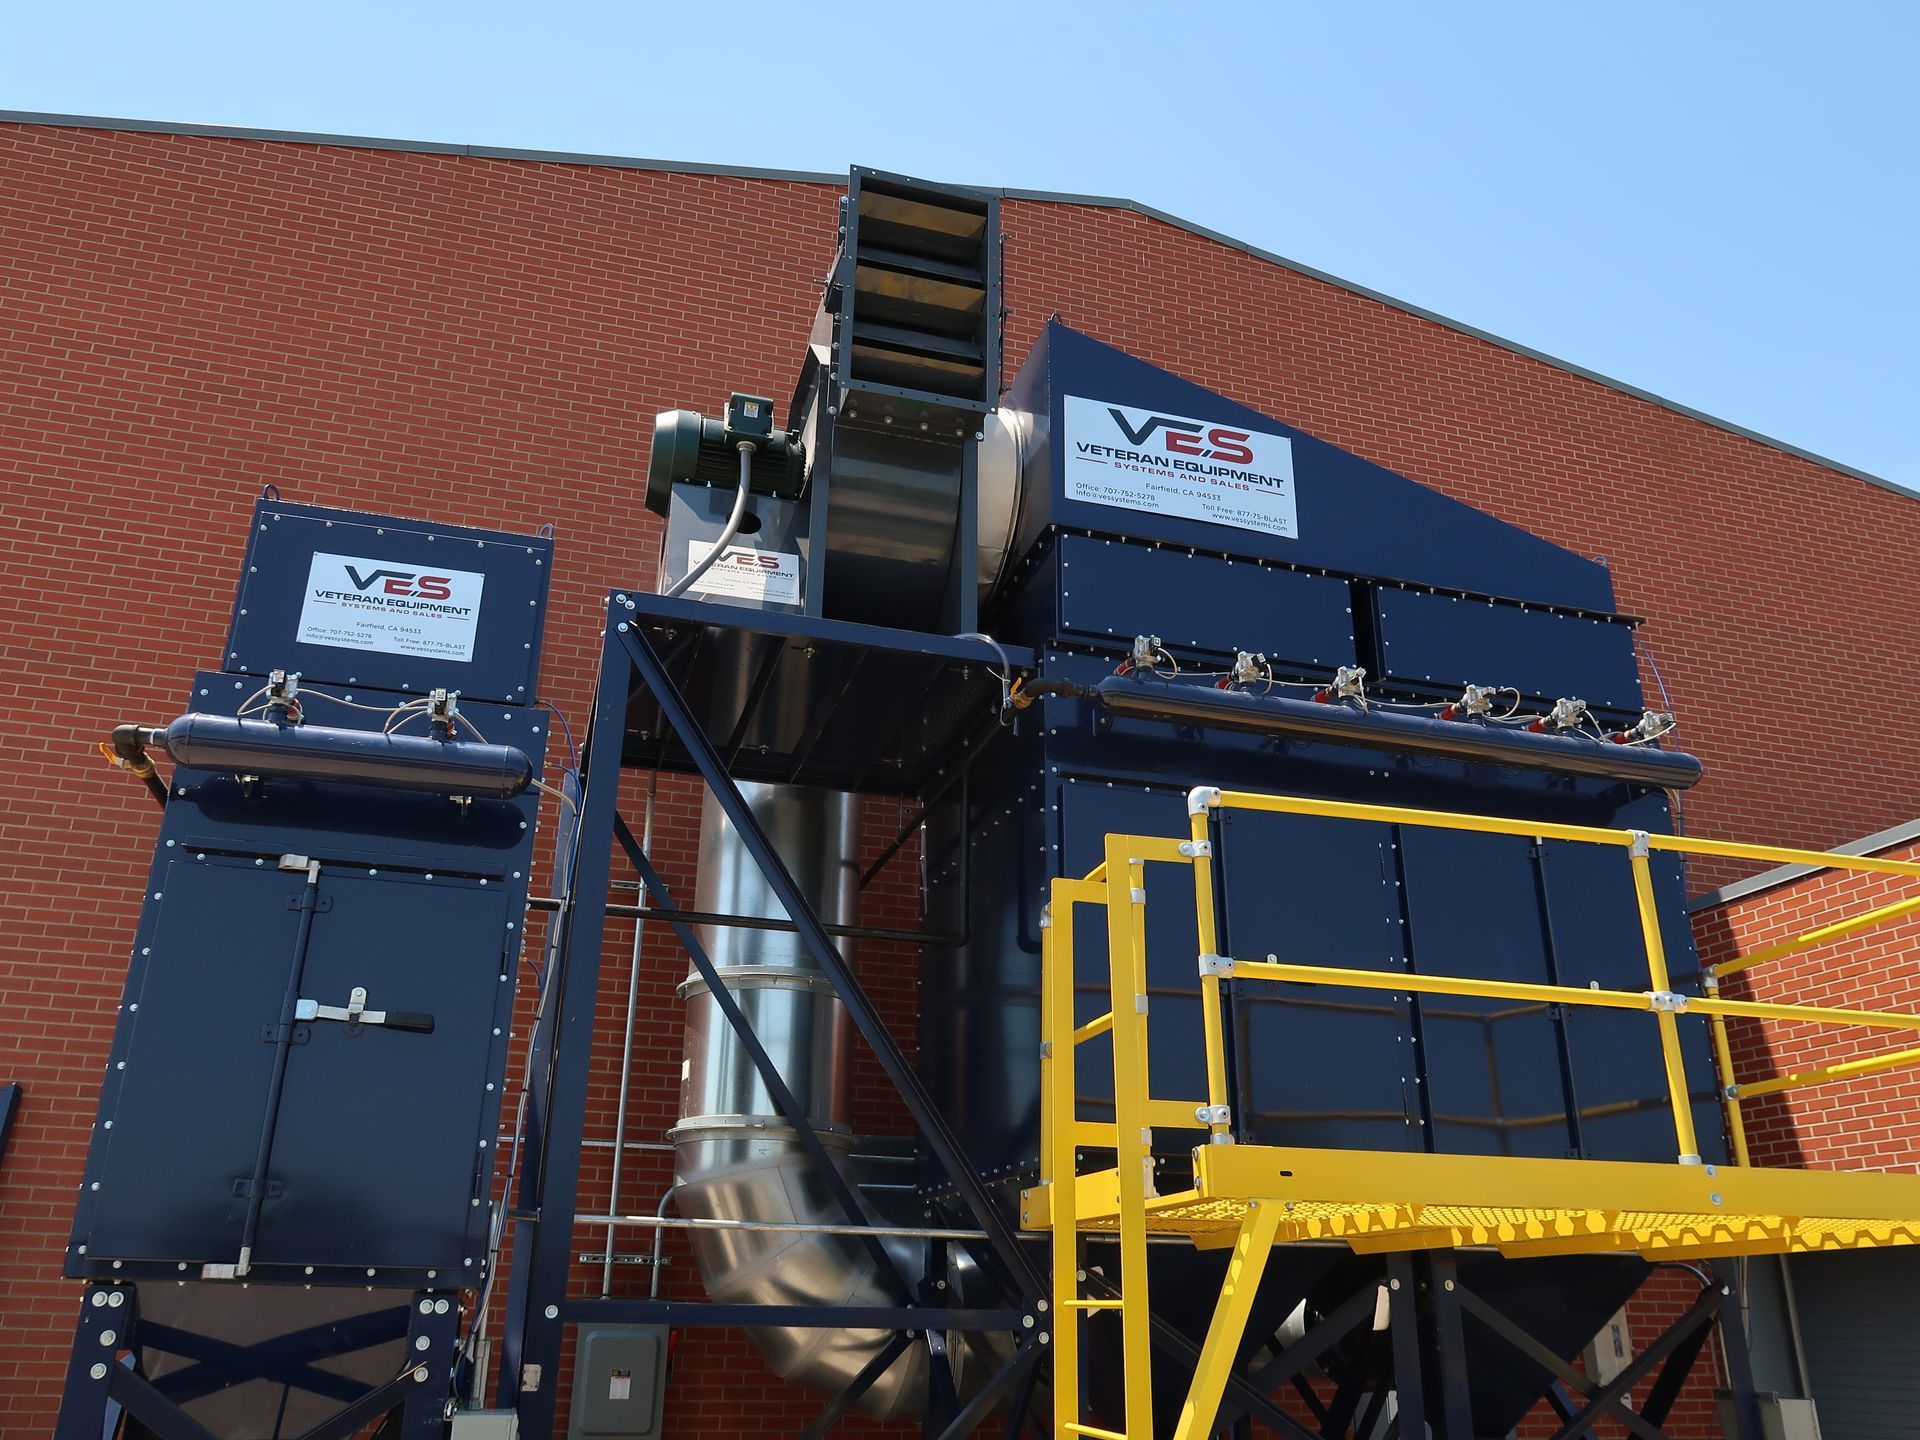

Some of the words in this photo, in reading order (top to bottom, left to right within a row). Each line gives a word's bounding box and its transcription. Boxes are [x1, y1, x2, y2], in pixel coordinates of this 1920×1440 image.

[1107, 408, 1253, 465] VES
[1076, 441, 1169, 468] VETERAN
[1173, 459, 1284, 489] EQUIPMENT
[1114, 461, 1175, 478] SYSTEMS
[1179, 473, 1206, 483] AND
[1210, 478, 1250, 491] SALES
[1075, 482, 1102, 492] Office:
[1103, 486, 1156, 501] 707-752-5278
[1145, 482, 1181, 495] Fairfield,
[1196, 491, 1221, 501] 94533
[1202, 503, 1215, 511] Toll
[1217, 506, 1236, 515] Free:
[1237, 509, 1287, 525] 877-75-BLAST
[1212, 512, 1288, 532] www.vessystems.com
[739, 566, 795, 578] EQUIPMENT
[344, 565, 452, 601] VES
[315, 589, 384, 605] VETERAN
[386, 598, 471, 616] EQUIPMENT
[341, 602, 386, 612] SYSTEMS
[413, 611, 443, 619] SALES
[307, 626, 328, 634] Office:
[329, 629, 372, 639] 707-752-5278
[356, 621, 386, 631] Fairfield,
[400, 626, 422, 635] 94533
[400, 645, 465, 656] www.vessystems.com
[422, 640, 466, 650] 877-75-BLAST
